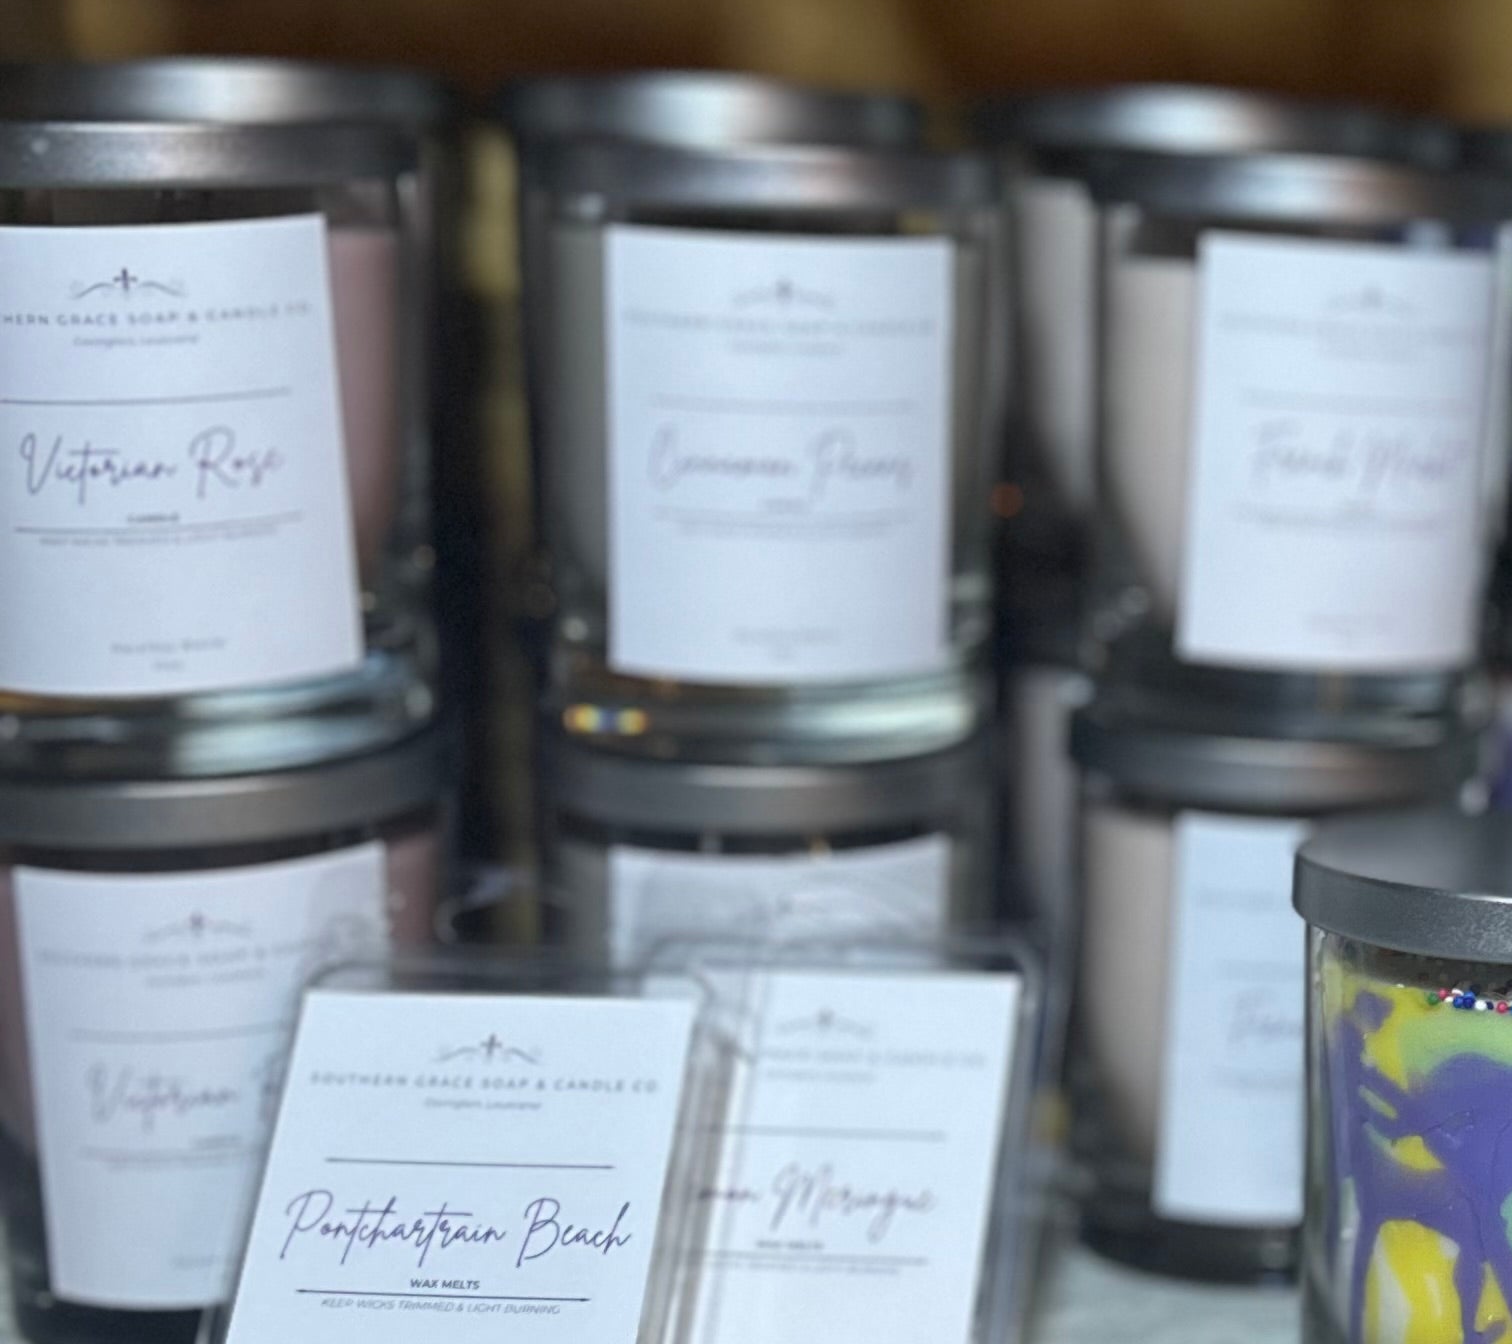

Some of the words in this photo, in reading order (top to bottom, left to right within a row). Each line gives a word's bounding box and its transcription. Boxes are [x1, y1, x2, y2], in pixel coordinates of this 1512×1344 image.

[19, 432, 178, 505] Victorian
[188, 425, 284, 499] Rose
[309, 1070, 408, 1088] SOUTHERN
[414, 1073, 474, 1089] GRACE
[481, 1075, 529, 1091] SOAP
[279, 1189, 507, 1268] Pontchartrain
[515, 1196, 632, 1269] Beach
[409, 1278, 440, 1291] WAX
[441, 1279, 481, 1291] MELTS
